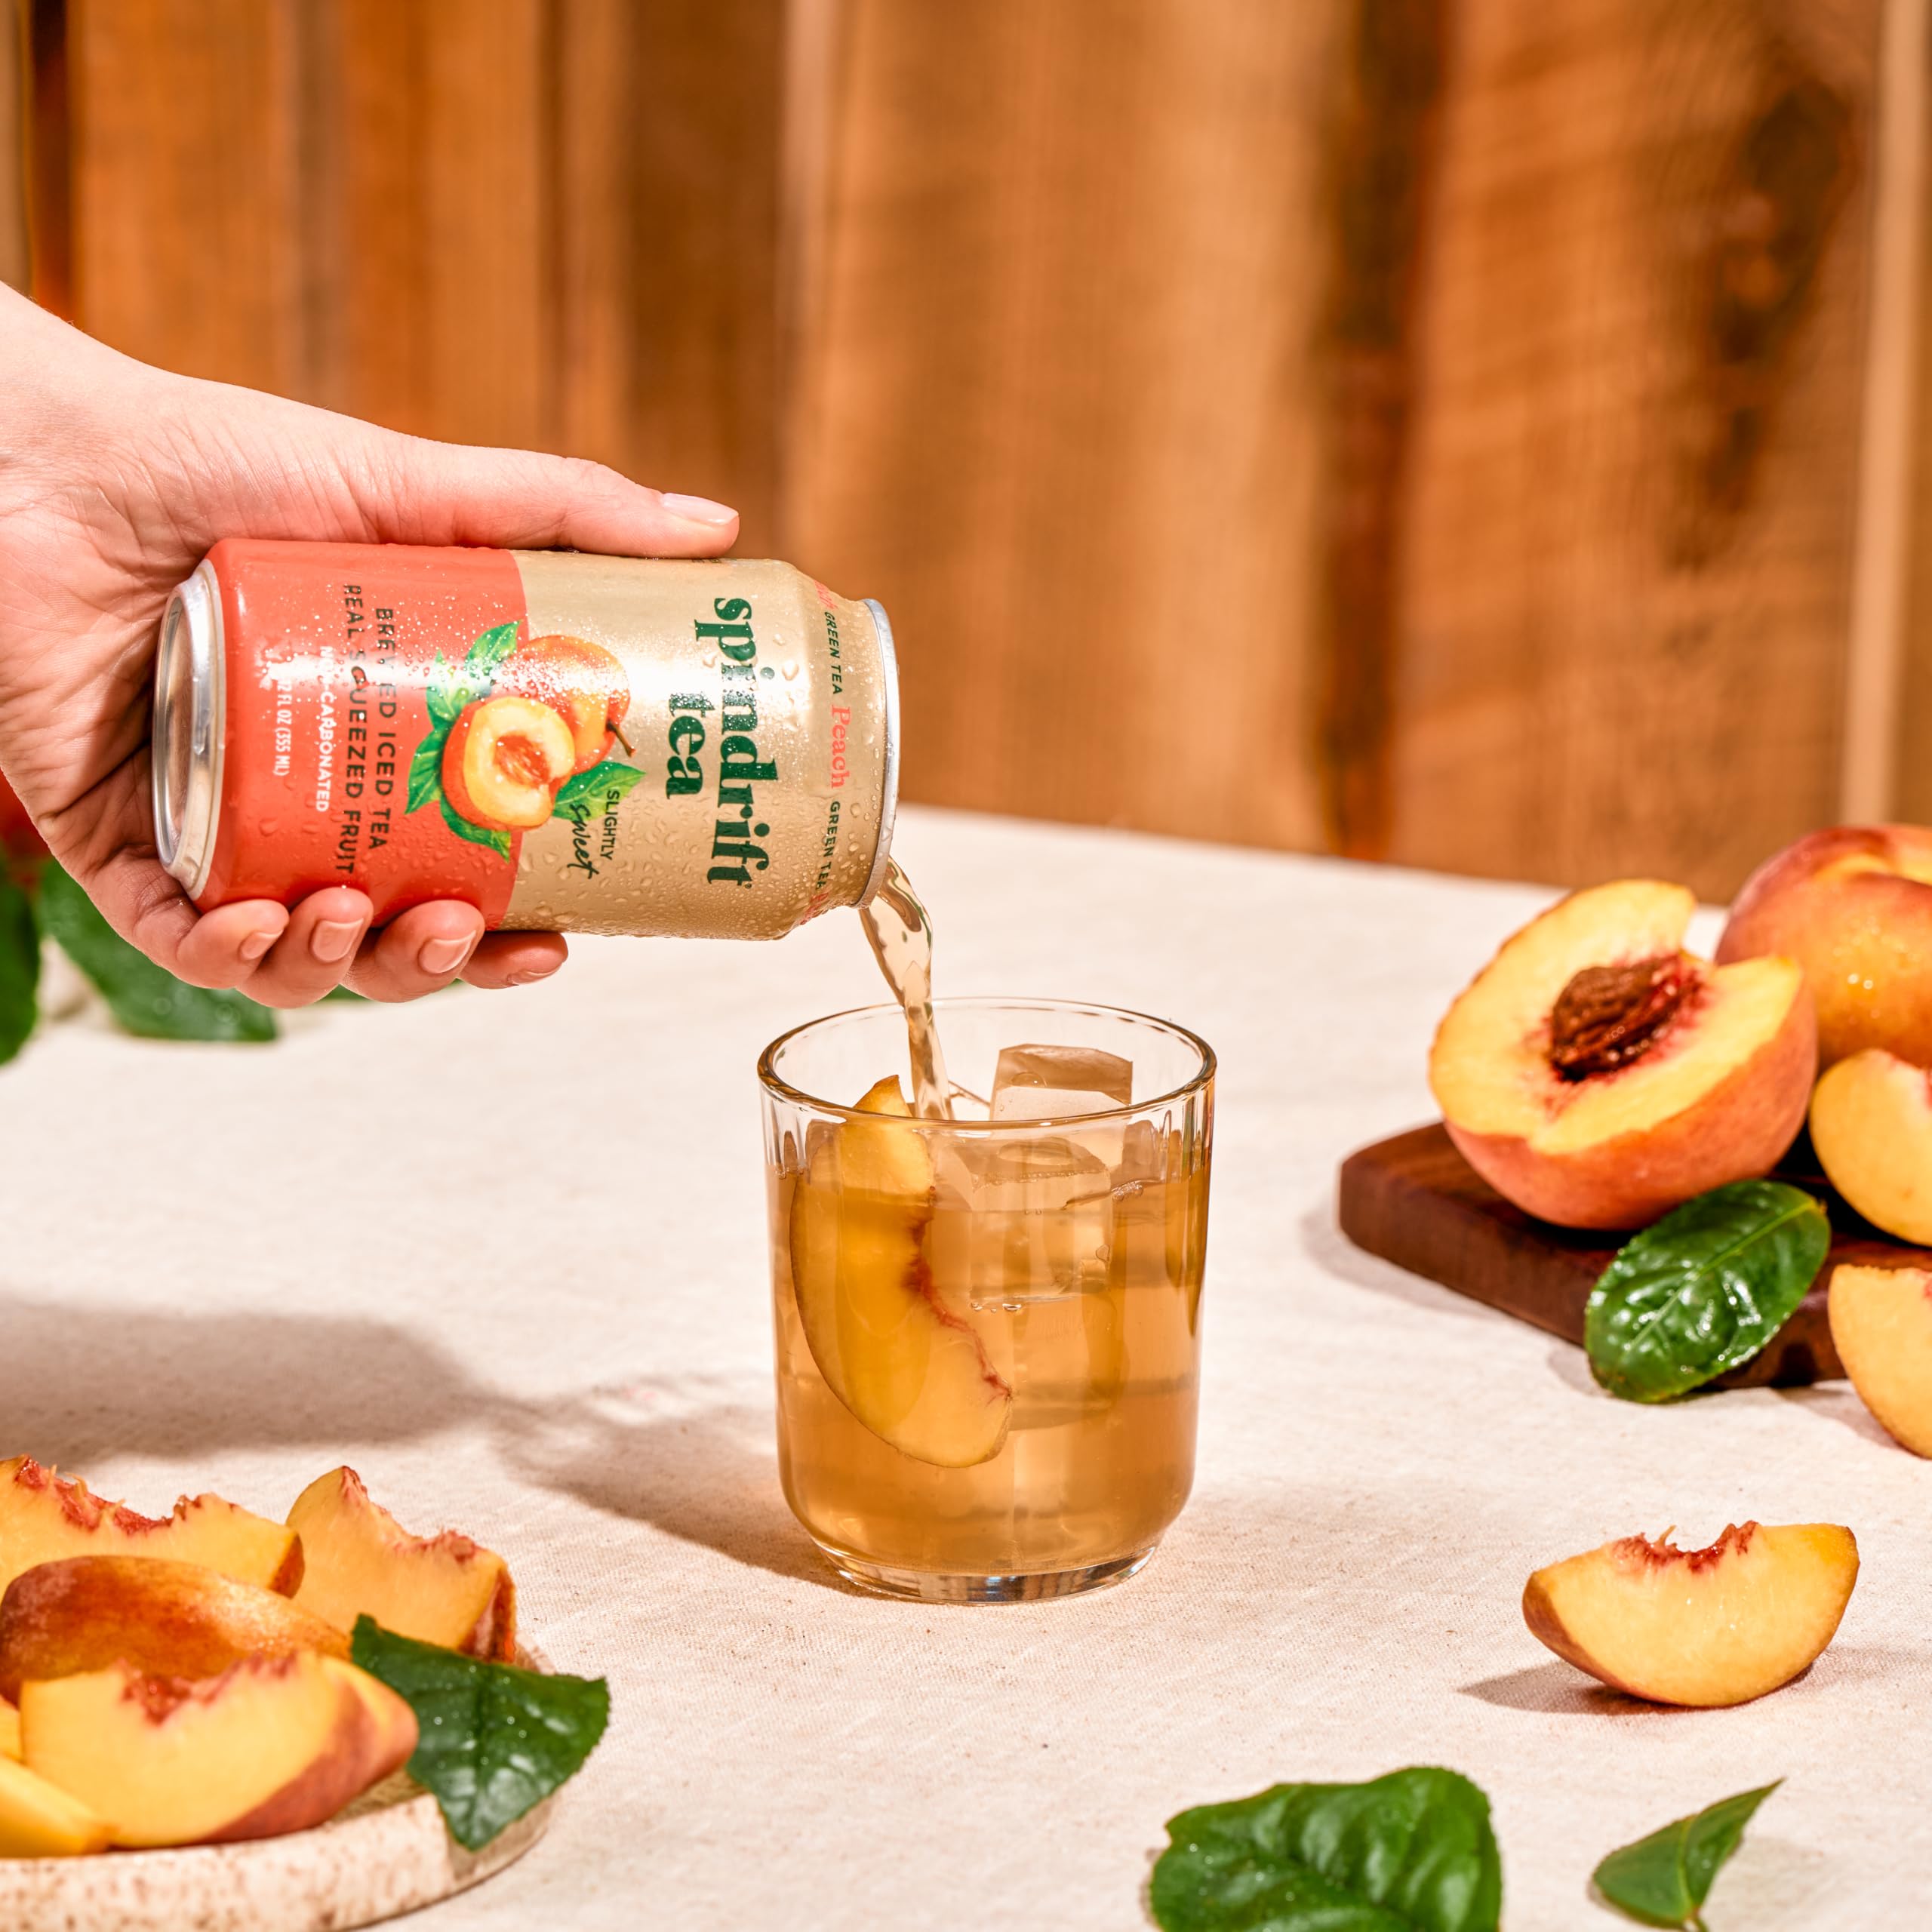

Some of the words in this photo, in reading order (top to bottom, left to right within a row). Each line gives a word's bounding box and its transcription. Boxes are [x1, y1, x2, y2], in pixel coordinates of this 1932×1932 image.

[343, 585, 365, 639] REAL
[824, 611, 841, 659] GREEN
[277, 694, 292, 706] FL
[831, 664, 843, 694] TEA
[275, 727, 291, 752] (355
[276, 710, 291, 724] OZ
[345, 650, 368, 798] SQUEEZED
[694, 597, 779, 885] spindrift
[273, 755, 291, 777] ML)
[375, 733, 395, 795] ICED
[666, 693, 715, 799] tea
[829, 705, 852, 789] Peach
[335, 810, 361, 875] FRUIT
[369, 808, 391, 849] TEA
[566, 804, 598, 879] sweet
[599, 790, 620, 860] SLIGHTLY
[823, 801, 841, 857] GREEN
[816, 861, 832, 890] TEA
